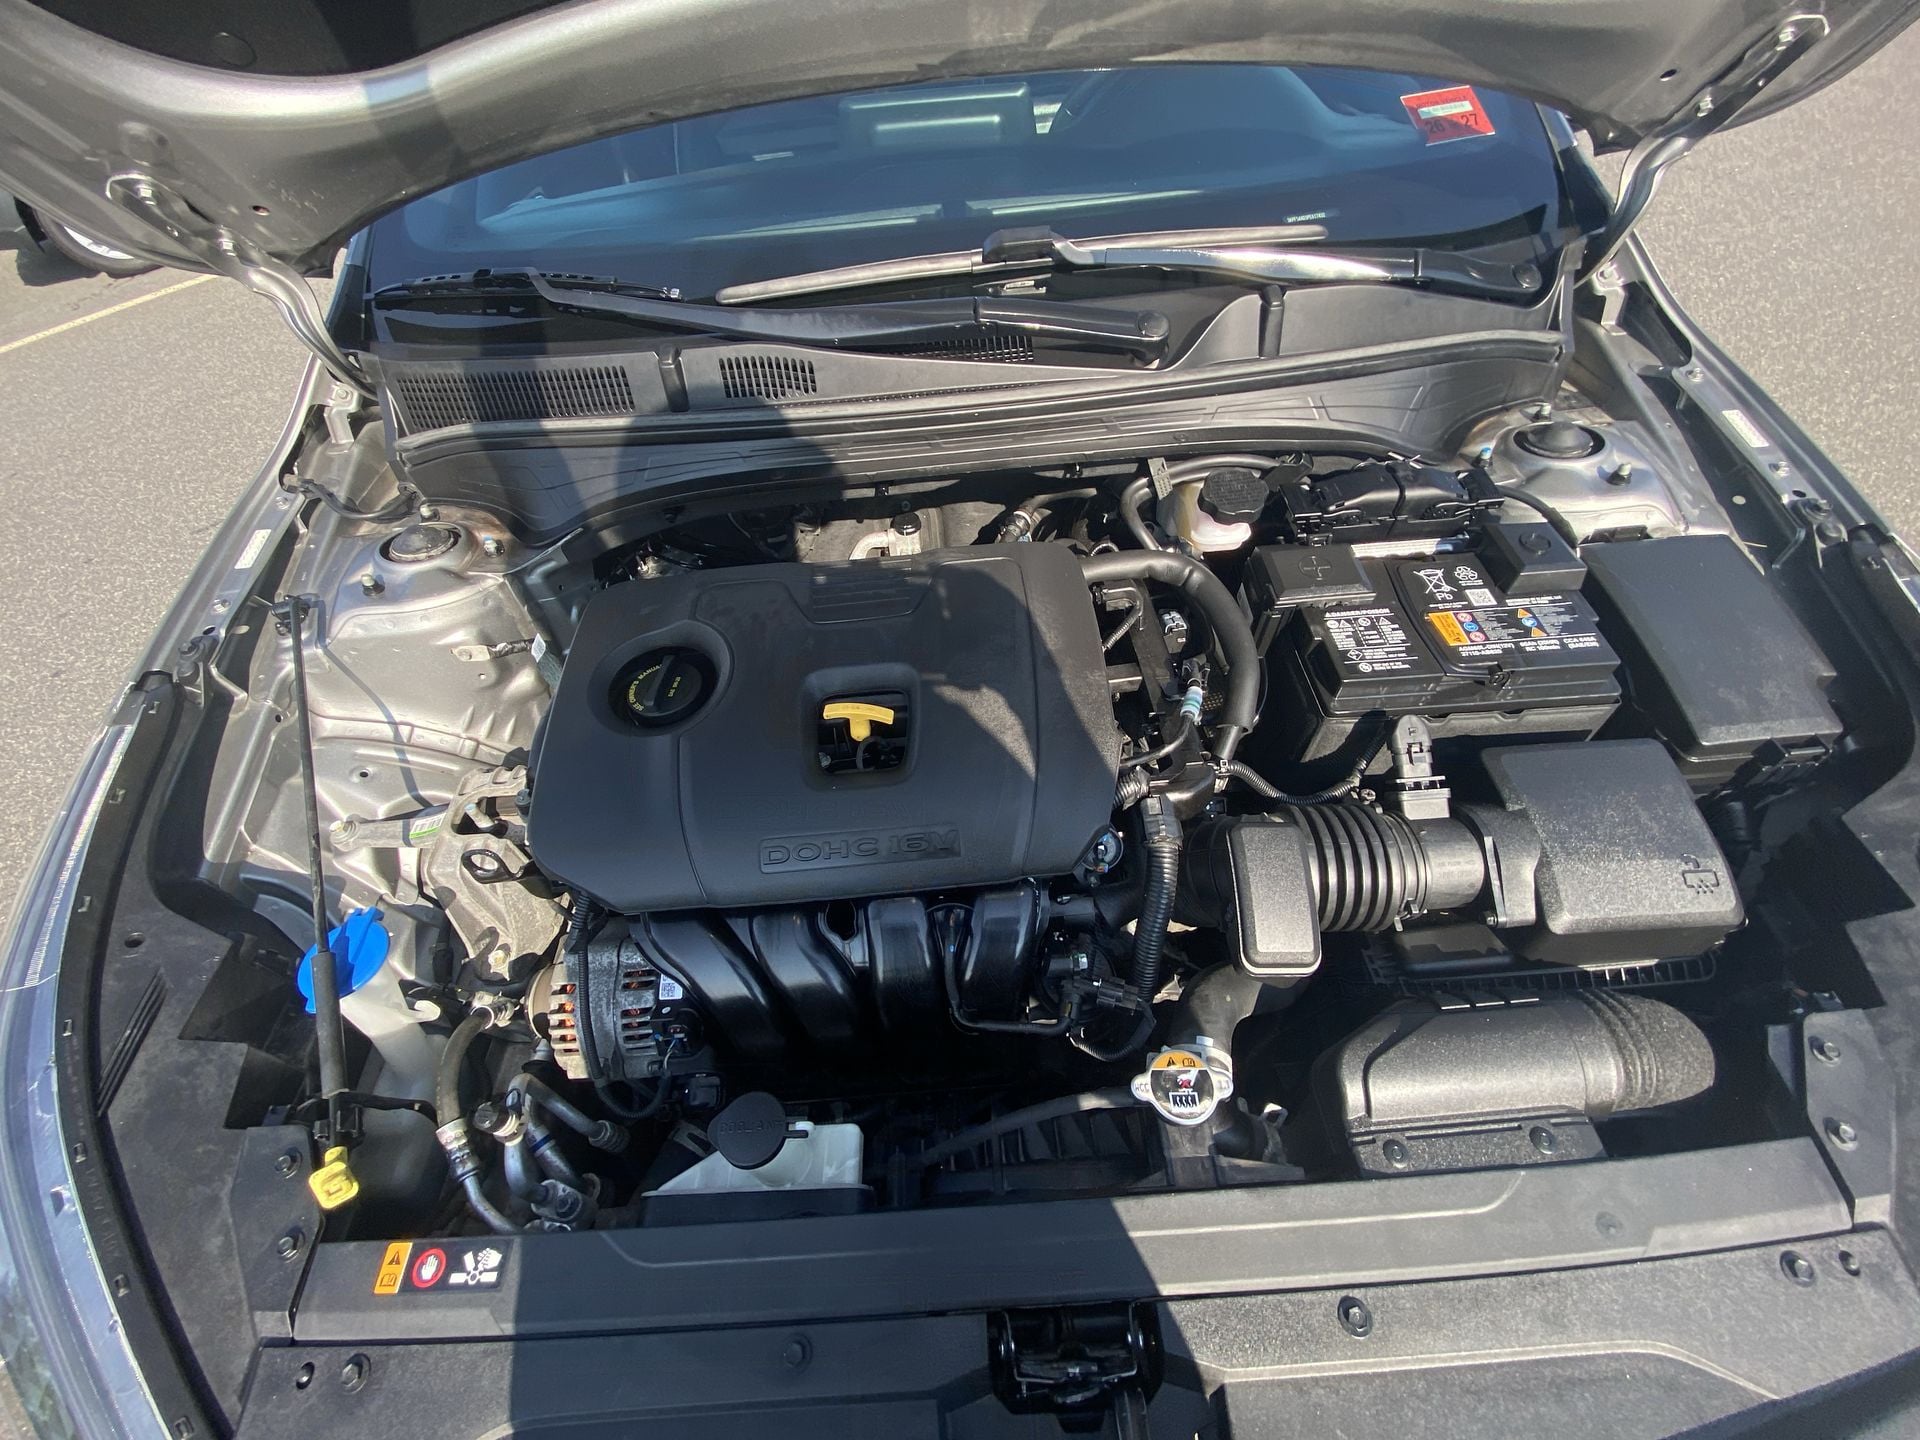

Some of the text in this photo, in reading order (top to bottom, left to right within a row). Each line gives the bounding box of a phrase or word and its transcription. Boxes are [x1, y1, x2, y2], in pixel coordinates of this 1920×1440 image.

[1424, 113, 1479, 134] 26 27
[1435, 592, 1454, 601] Pb
[763, 837, 880, 866] DOHC
